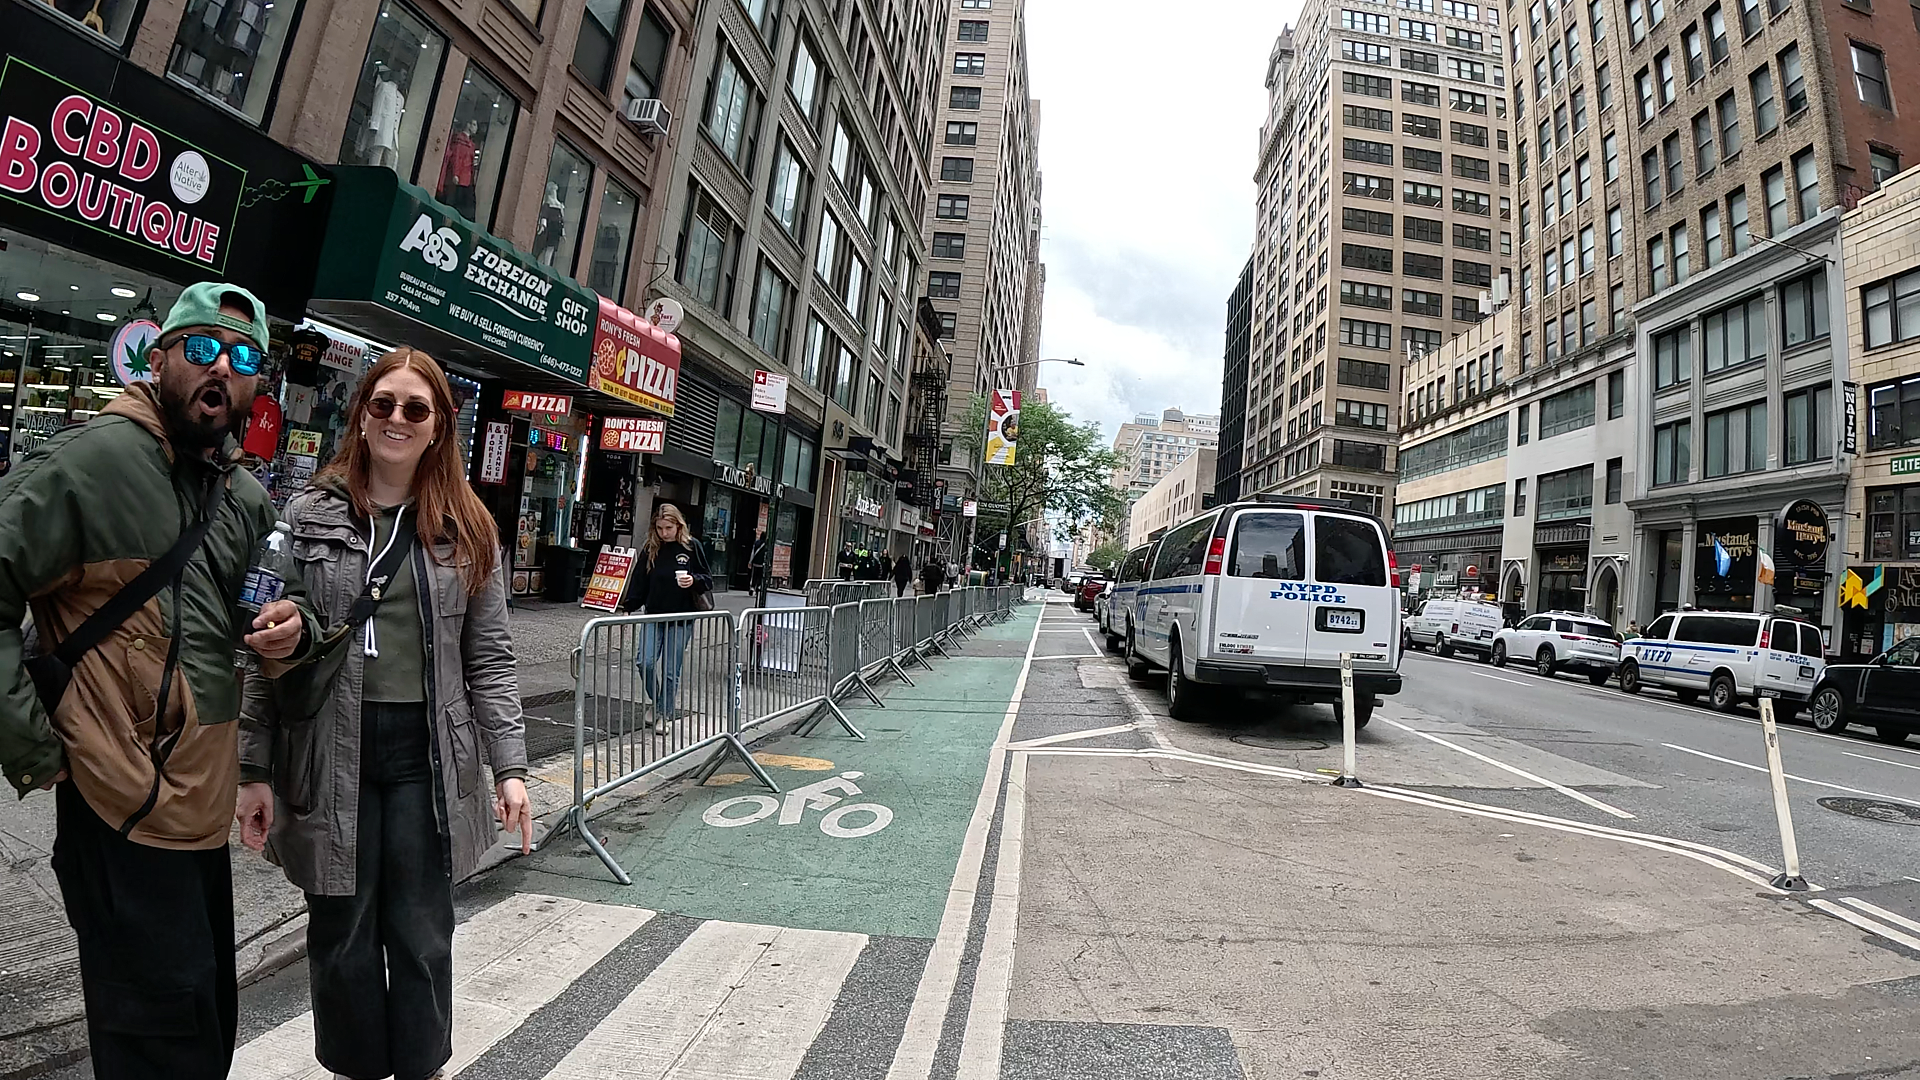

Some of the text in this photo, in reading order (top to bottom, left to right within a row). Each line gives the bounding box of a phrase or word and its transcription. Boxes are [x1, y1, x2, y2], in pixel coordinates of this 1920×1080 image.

[51, 94, 161, 182] CBD
[176, 161, 199, 178] Alter
[0, 115, 221, 264] BOUTIQUE
[174, 170, 202, 191] Native
[398, 213, 462, 272] A&S
[469, 245, 553, 297] FOREIGN
[400, 271, 447, 298] BUREAU DE CHANGE
[401, 283, 440, 306] CASA DE CAMBIO
[463, 262, 549, 316] EXCHANGE
[385, 290, 400, 302] 357
[561, 297, 589, 321] GIFT
[448, 303, 545, 353] WE BUY & SELL FOREIGN CURRENCY
[554, 311, 588, 337] SHOP
[600, 318, 641, 348] RONY'S FRESH
[328, 338, 362, 358] OREIGN
[482, 332, 508, 348] WECHSEL
[623, 348, 676, 402] PIZZA
[521, 394, 566, 413] PIZZA
[259, 418, 274, 432] NY
[604, 418, 664, 432] RONY'S FRESH
[1845, 392, 1856, 449] NAILS
[619, 431, 661, 450] PIZZA
[485, 434, 495, 477] FOREIGN
[495, 434, 504, 477] EXCHANGE
[1891, 457, 1920, 473] ELITE
[722, 465, 746, 488] KINGS
[1724, 544, 1753, 562] rry's
[593, 577, 619, 589] PIZZA
[1279, 582, 1337, 594] NYPD
[1269, 591, 1346, 604] POLICE
[1329, 614, 1351, 625] 8742
[1641, 649, 1672, 663] NYPD
[1785, 658, 1811, 666] POLICE
